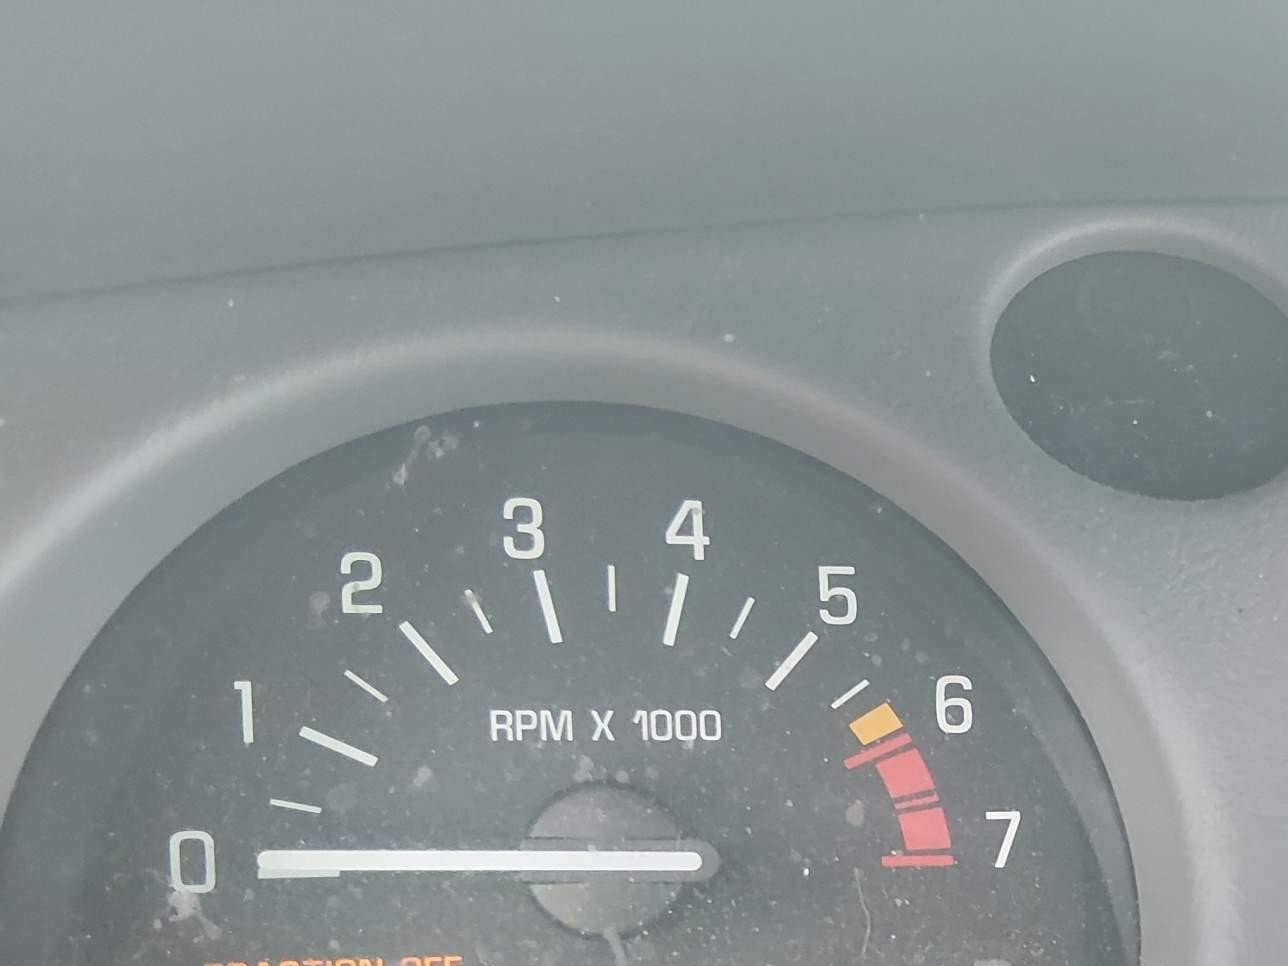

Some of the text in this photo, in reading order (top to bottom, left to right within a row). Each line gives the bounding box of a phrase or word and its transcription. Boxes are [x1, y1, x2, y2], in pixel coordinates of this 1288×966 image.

[503, 497, 545, 560] 3
[665, 500, 710, 561] 4
[340, 552, 384, 614] 2
[818, 566, 858, 625] 5
[234, 680, 254, 745] 1
[490, 709, 722, 742] RPM X 1000
[935, 675, 974, 734] 6
[168, 830, 216, 894] 0
[985, 811, 1022, 868] 7
